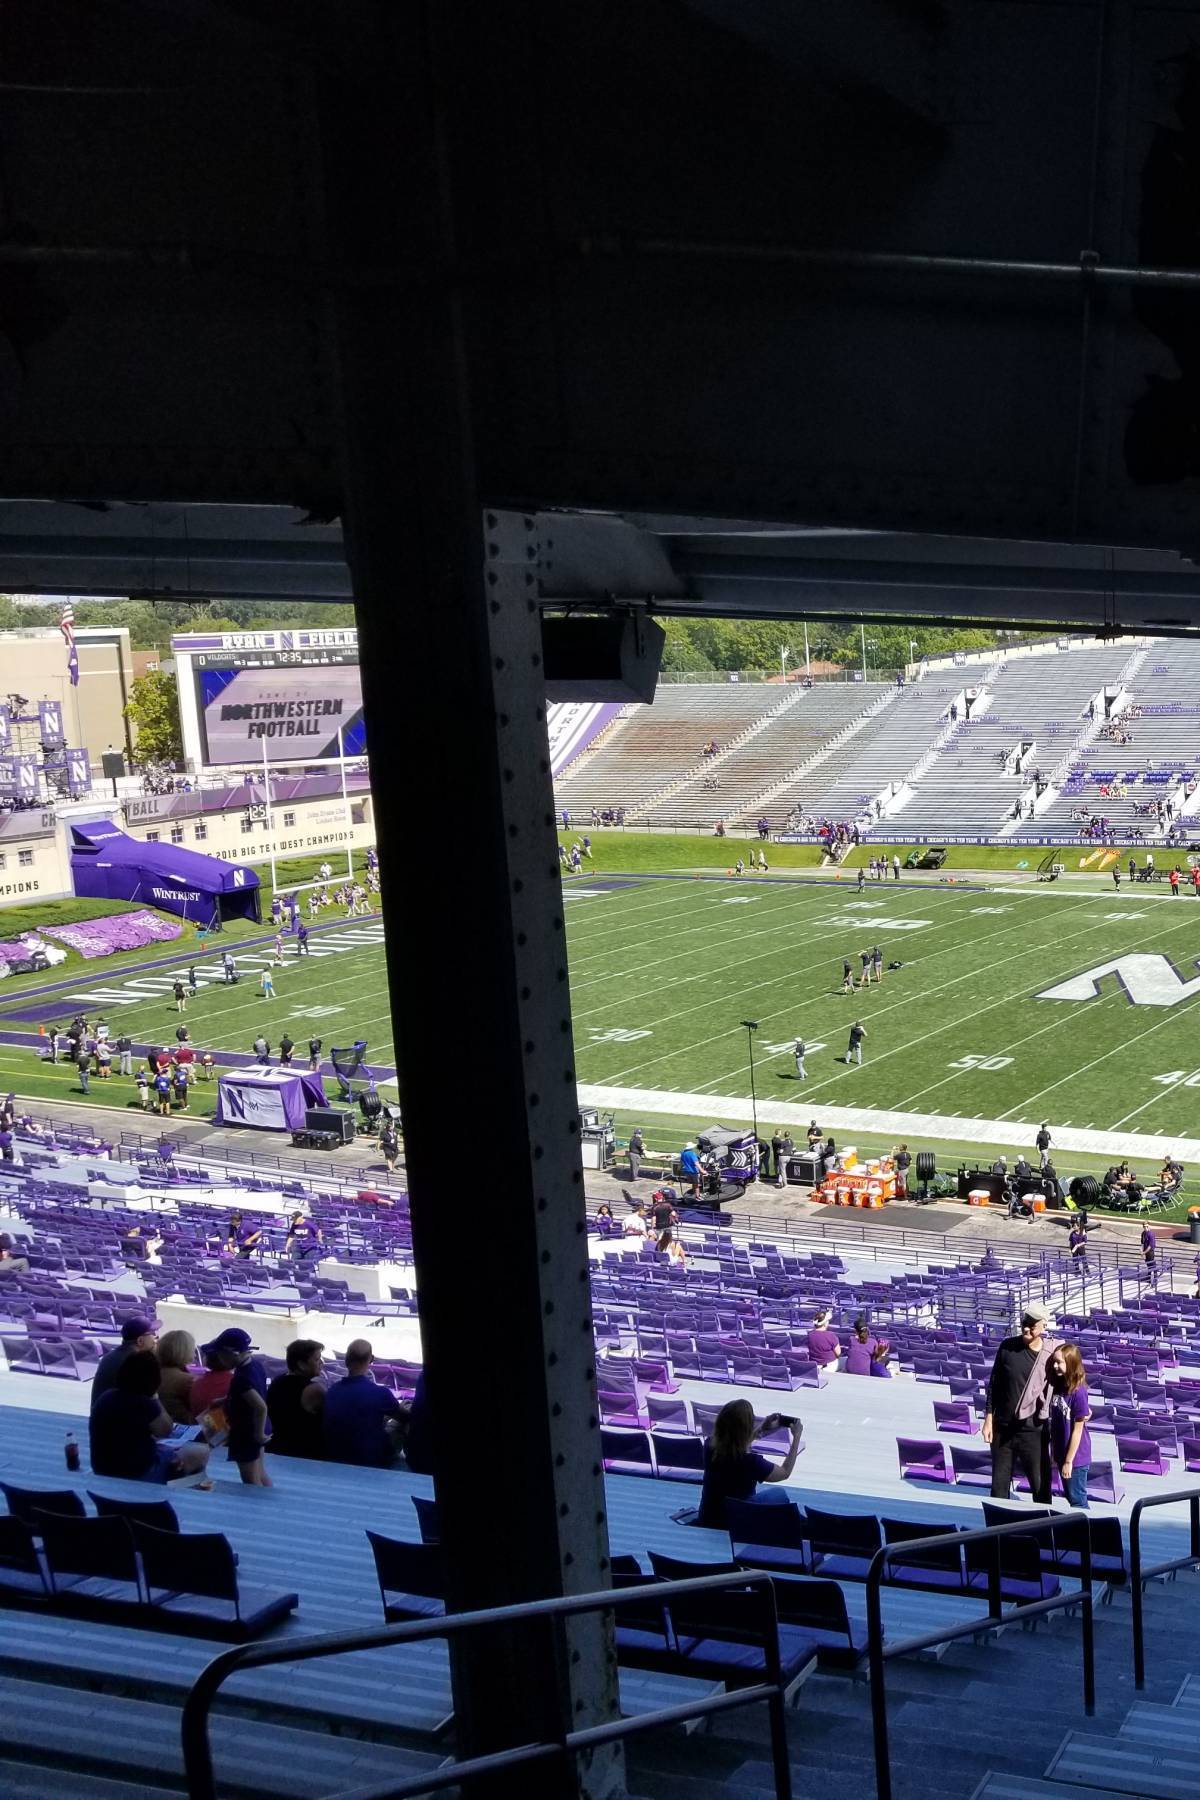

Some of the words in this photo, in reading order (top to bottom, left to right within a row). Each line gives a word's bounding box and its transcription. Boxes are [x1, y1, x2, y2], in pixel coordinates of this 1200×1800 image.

[222, 635, 264, 650] RYAN
[310, 632, 355, 647] FIELD
[221, 699, 343, 721] NORTHWESTERN
[44, 712, 59, 734] N
[247, 719, 320, 739] FOOTBALL
[20, 764, 36, 787] N
[72, 760, 87, 782] N
[241, 847, 256, 857] BIG
[280, 838, 304, 851] WEST
[233, 869, 246, 887] N
[588, 1028, 653, 1042] 30
[762, 1040, 829, 1055] 40
[946, 1054, 1015, 1071] 50
[226, 1087, 246, 1119] N
